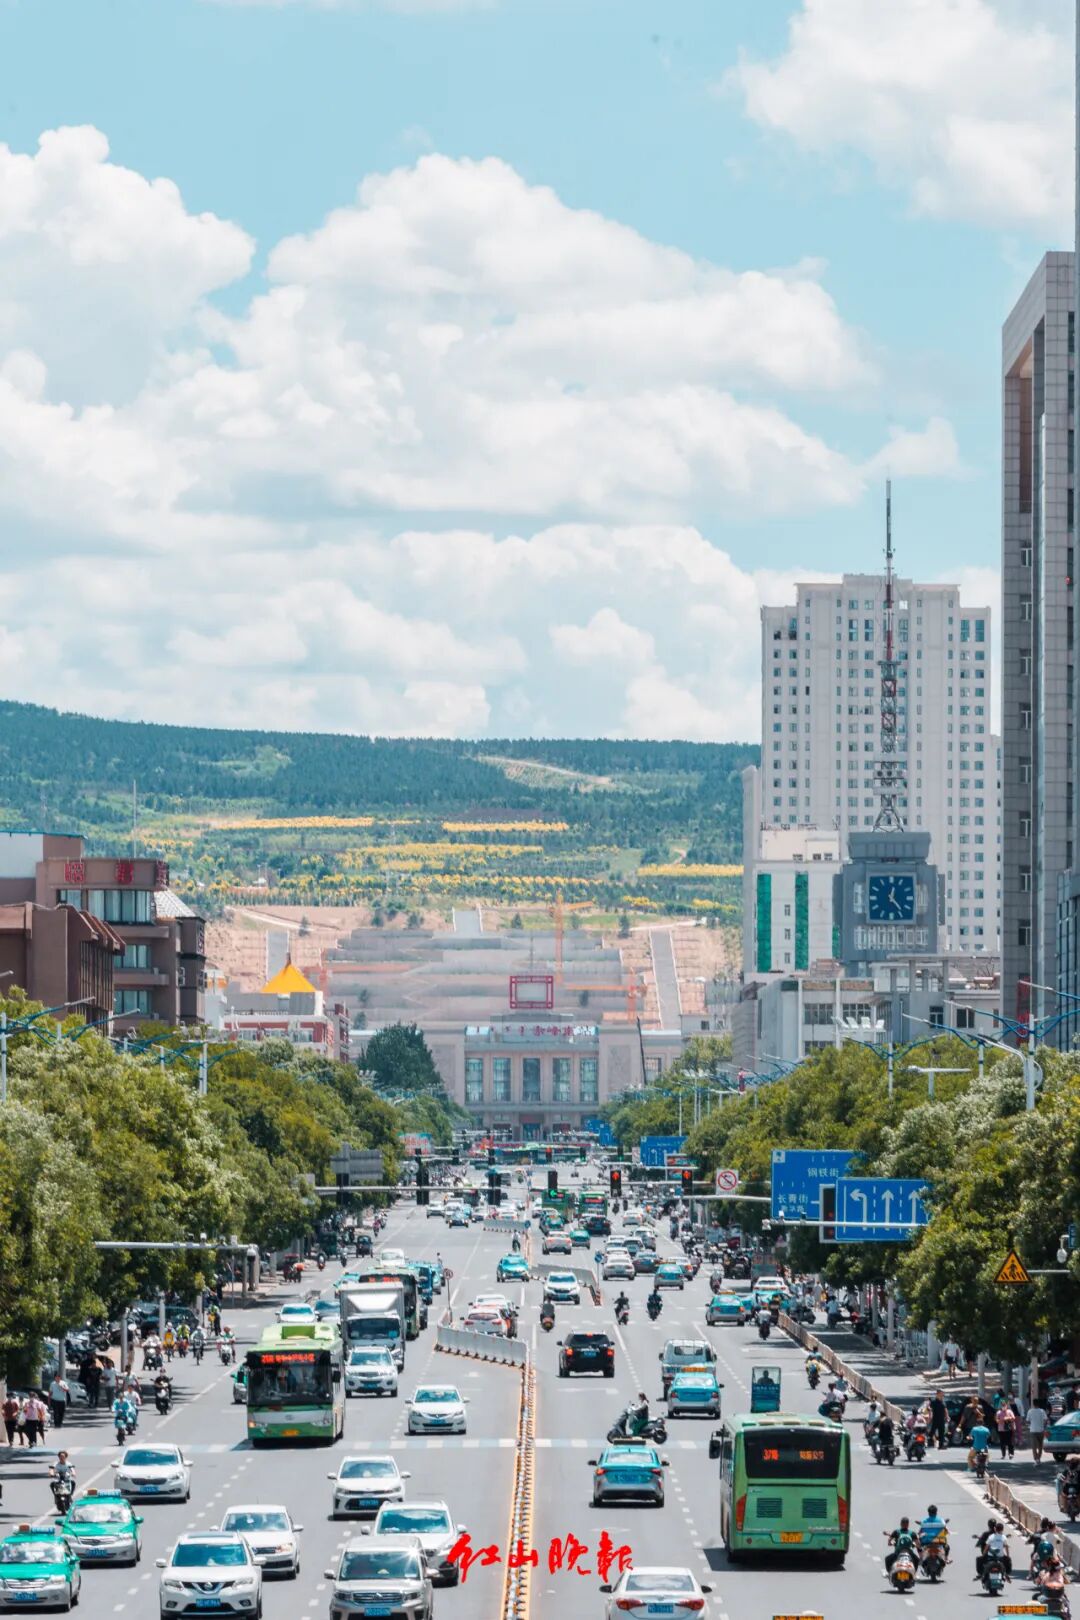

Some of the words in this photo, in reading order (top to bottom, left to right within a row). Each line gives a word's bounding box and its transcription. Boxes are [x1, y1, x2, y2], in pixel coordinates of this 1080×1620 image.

[807, 1168, 839, 1178] 钢铁街
[777, 1193, 808, 1204] 长青街
